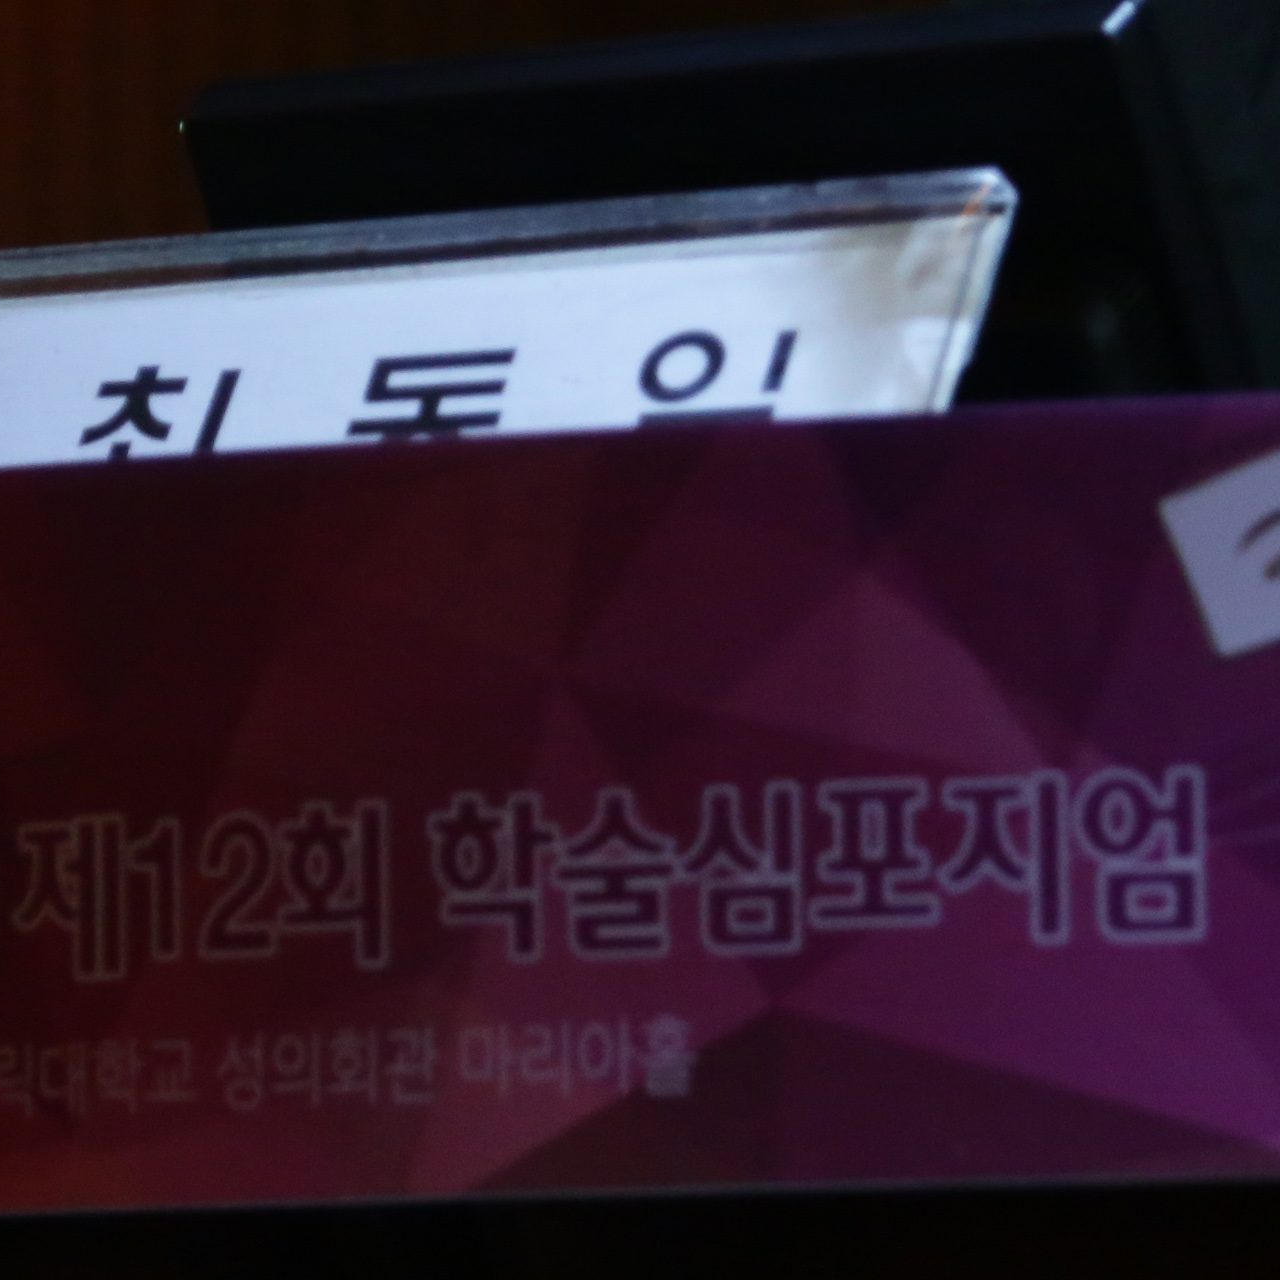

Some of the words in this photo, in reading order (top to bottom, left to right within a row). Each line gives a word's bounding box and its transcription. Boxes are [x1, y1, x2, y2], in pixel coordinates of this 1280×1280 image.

[14, 796, 390, 982] 제12회
[426, 763, 1208, 965] 학술심포지엄
[216, 1026, 436, 1112] 성의회관
[458, 1013, 698, 1100] 마리아홀
